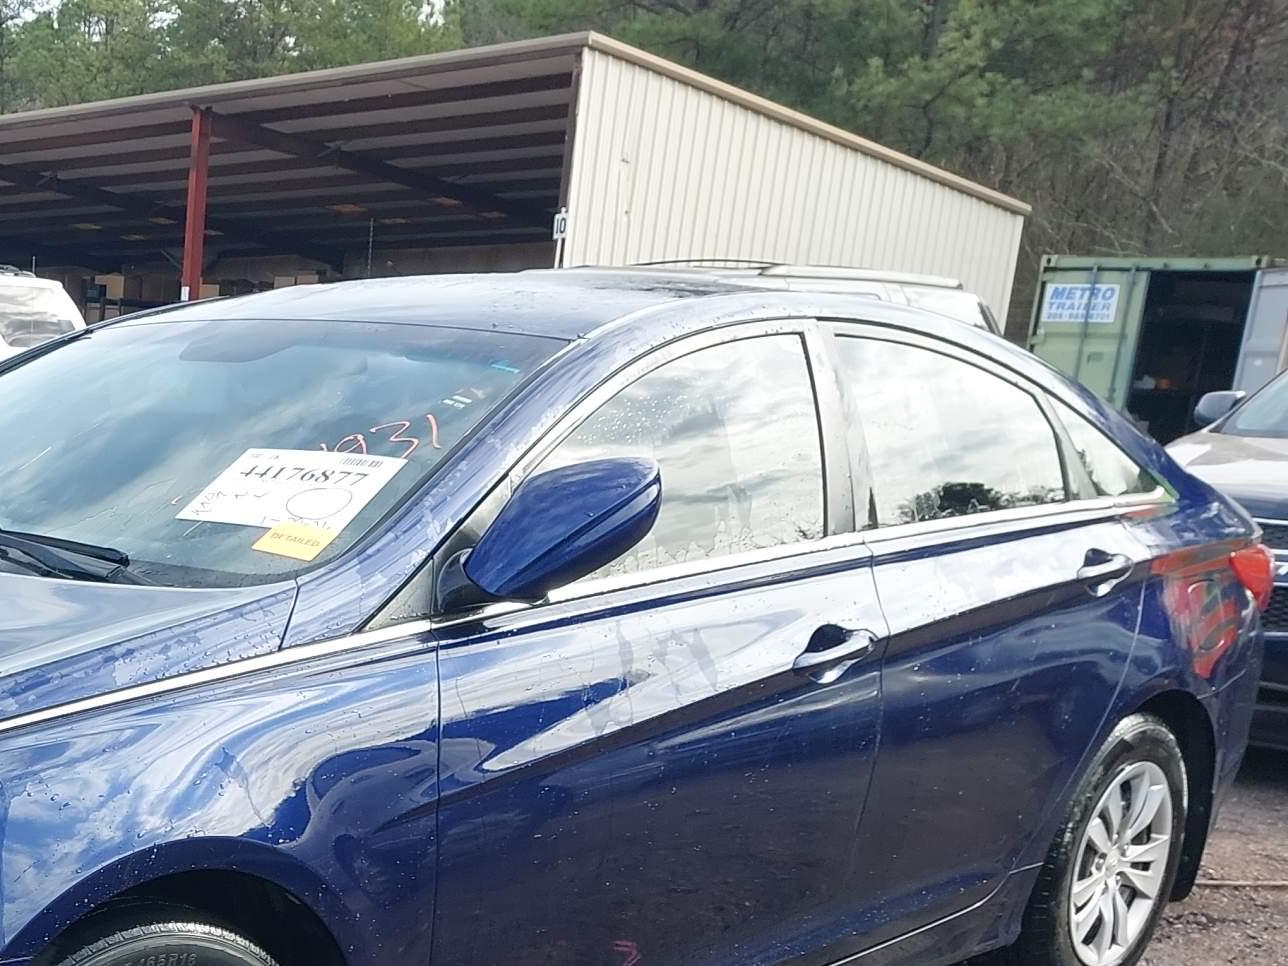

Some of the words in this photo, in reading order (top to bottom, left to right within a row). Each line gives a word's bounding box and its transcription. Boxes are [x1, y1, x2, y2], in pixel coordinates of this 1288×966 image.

[1050, 286, 1115, 301] METRO
[239, 464, 369, 487] 44176877
[270, 532, 321, 548] DETAILED
